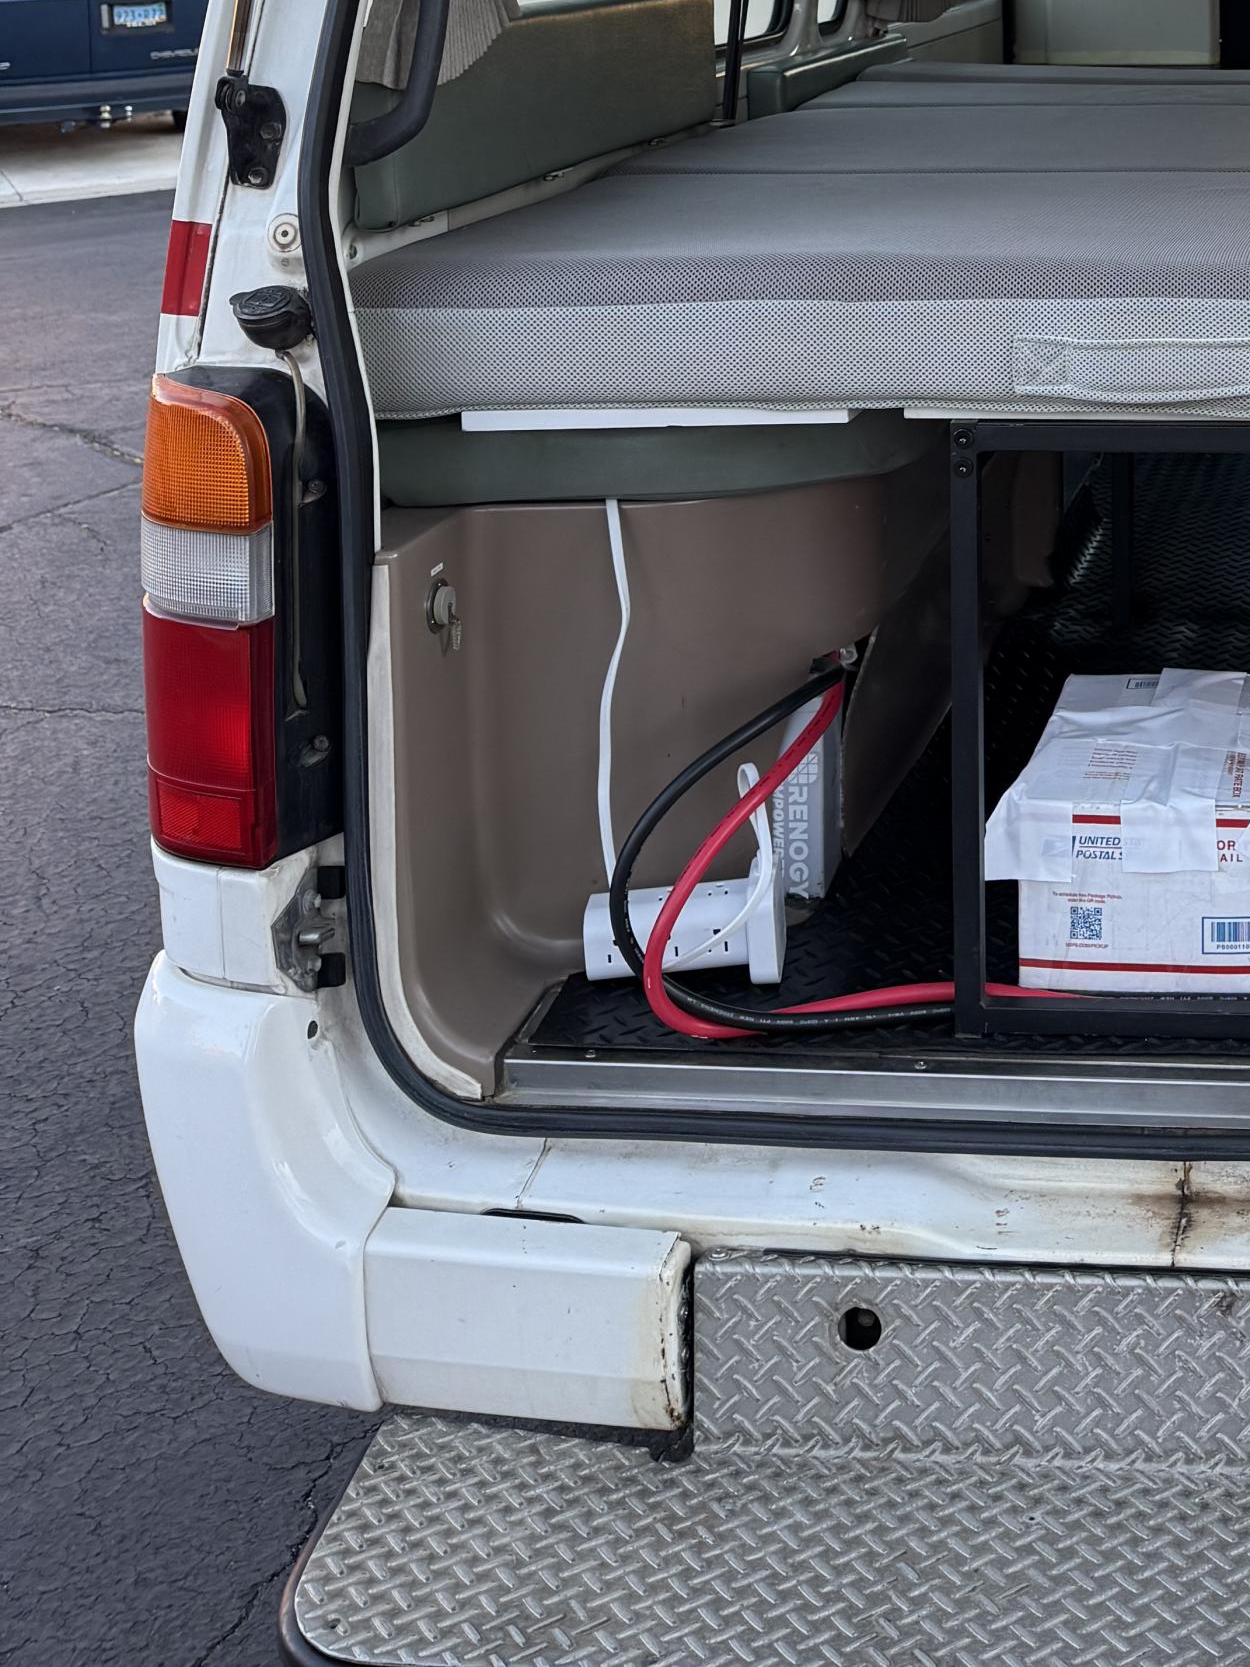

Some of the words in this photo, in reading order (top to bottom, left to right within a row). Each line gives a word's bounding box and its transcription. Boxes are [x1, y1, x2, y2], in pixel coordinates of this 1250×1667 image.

[1232, 787, 1242, 798] BOX
[788, 786, 809, 900] RENOGY
[1079, 835, 1121, 846] UNITED
[1076, 850, 1117, 860] POSTAL
[1220, 853, 1243, 862] AIL
